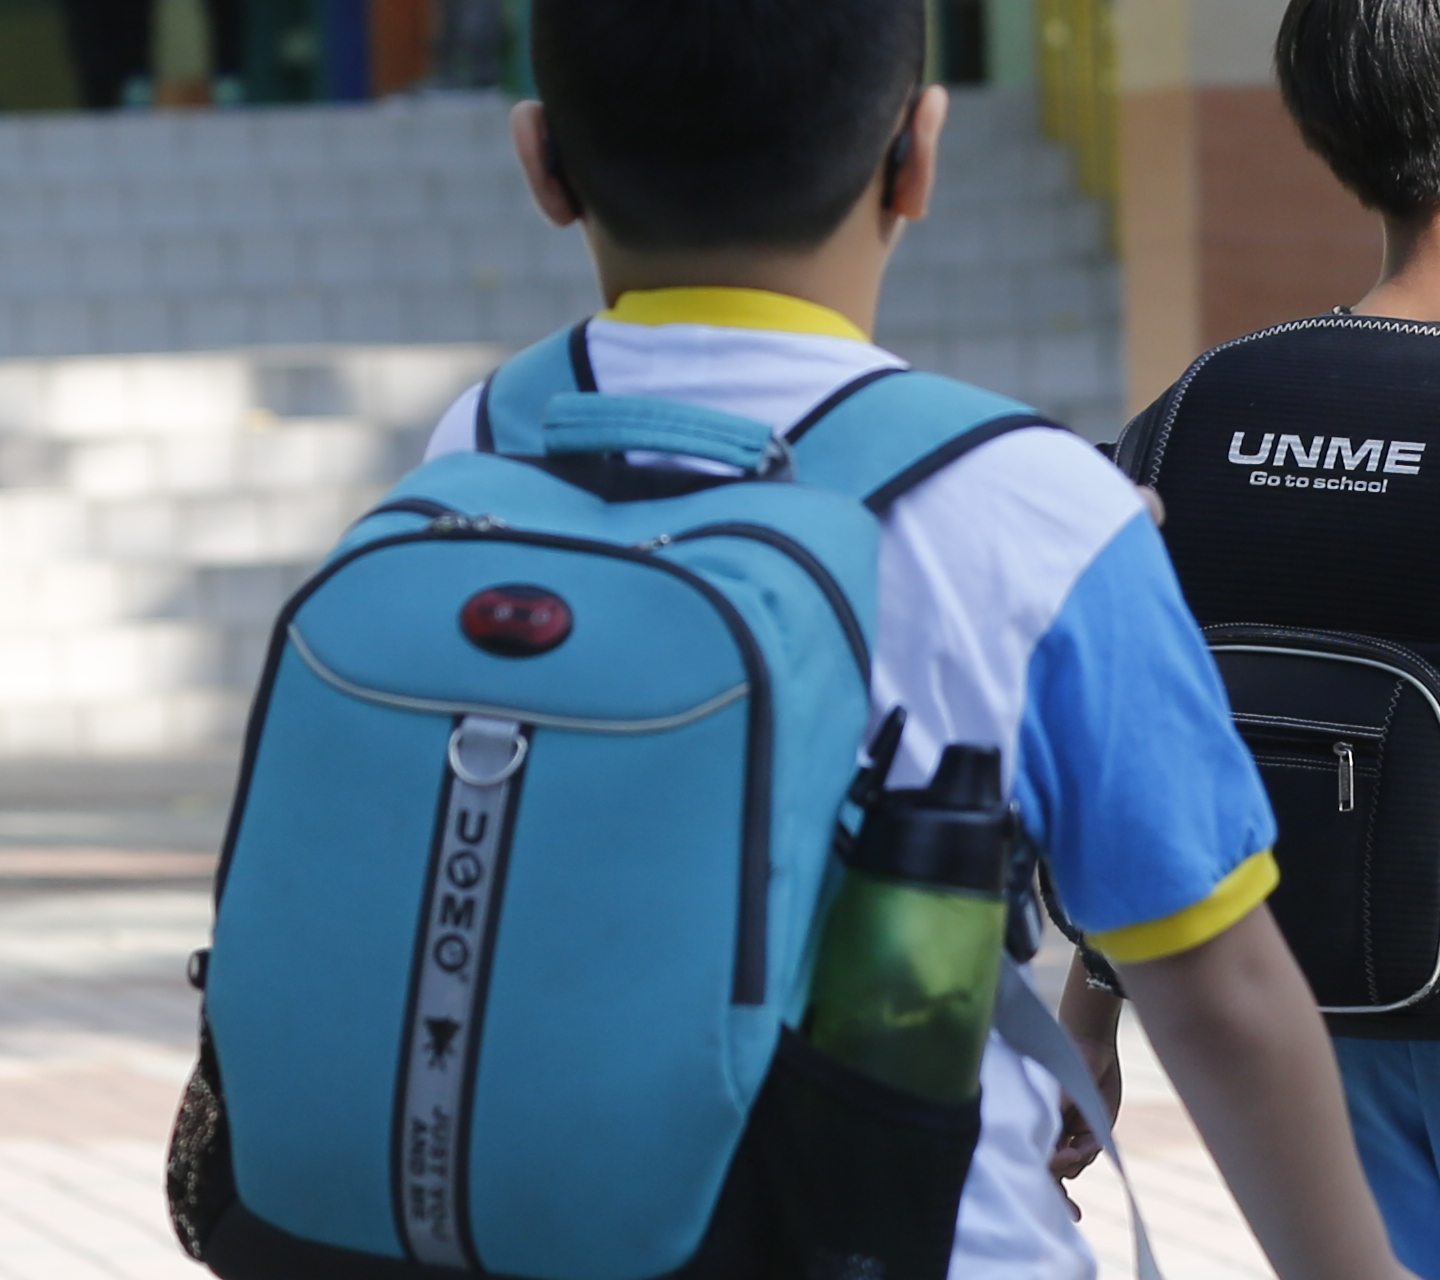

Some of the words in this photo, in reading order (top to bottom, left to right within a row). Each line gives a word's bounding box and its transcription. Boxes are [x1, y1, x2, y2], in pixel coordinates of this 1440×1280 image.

[1228, 431, 1427, 475] UNME
[1249, 470, 1282, 487] Go
[1284, 474, 1310, 488] to
[1312, 475, 1389, 493] school
[434, 809, 488, 974] UOMO
